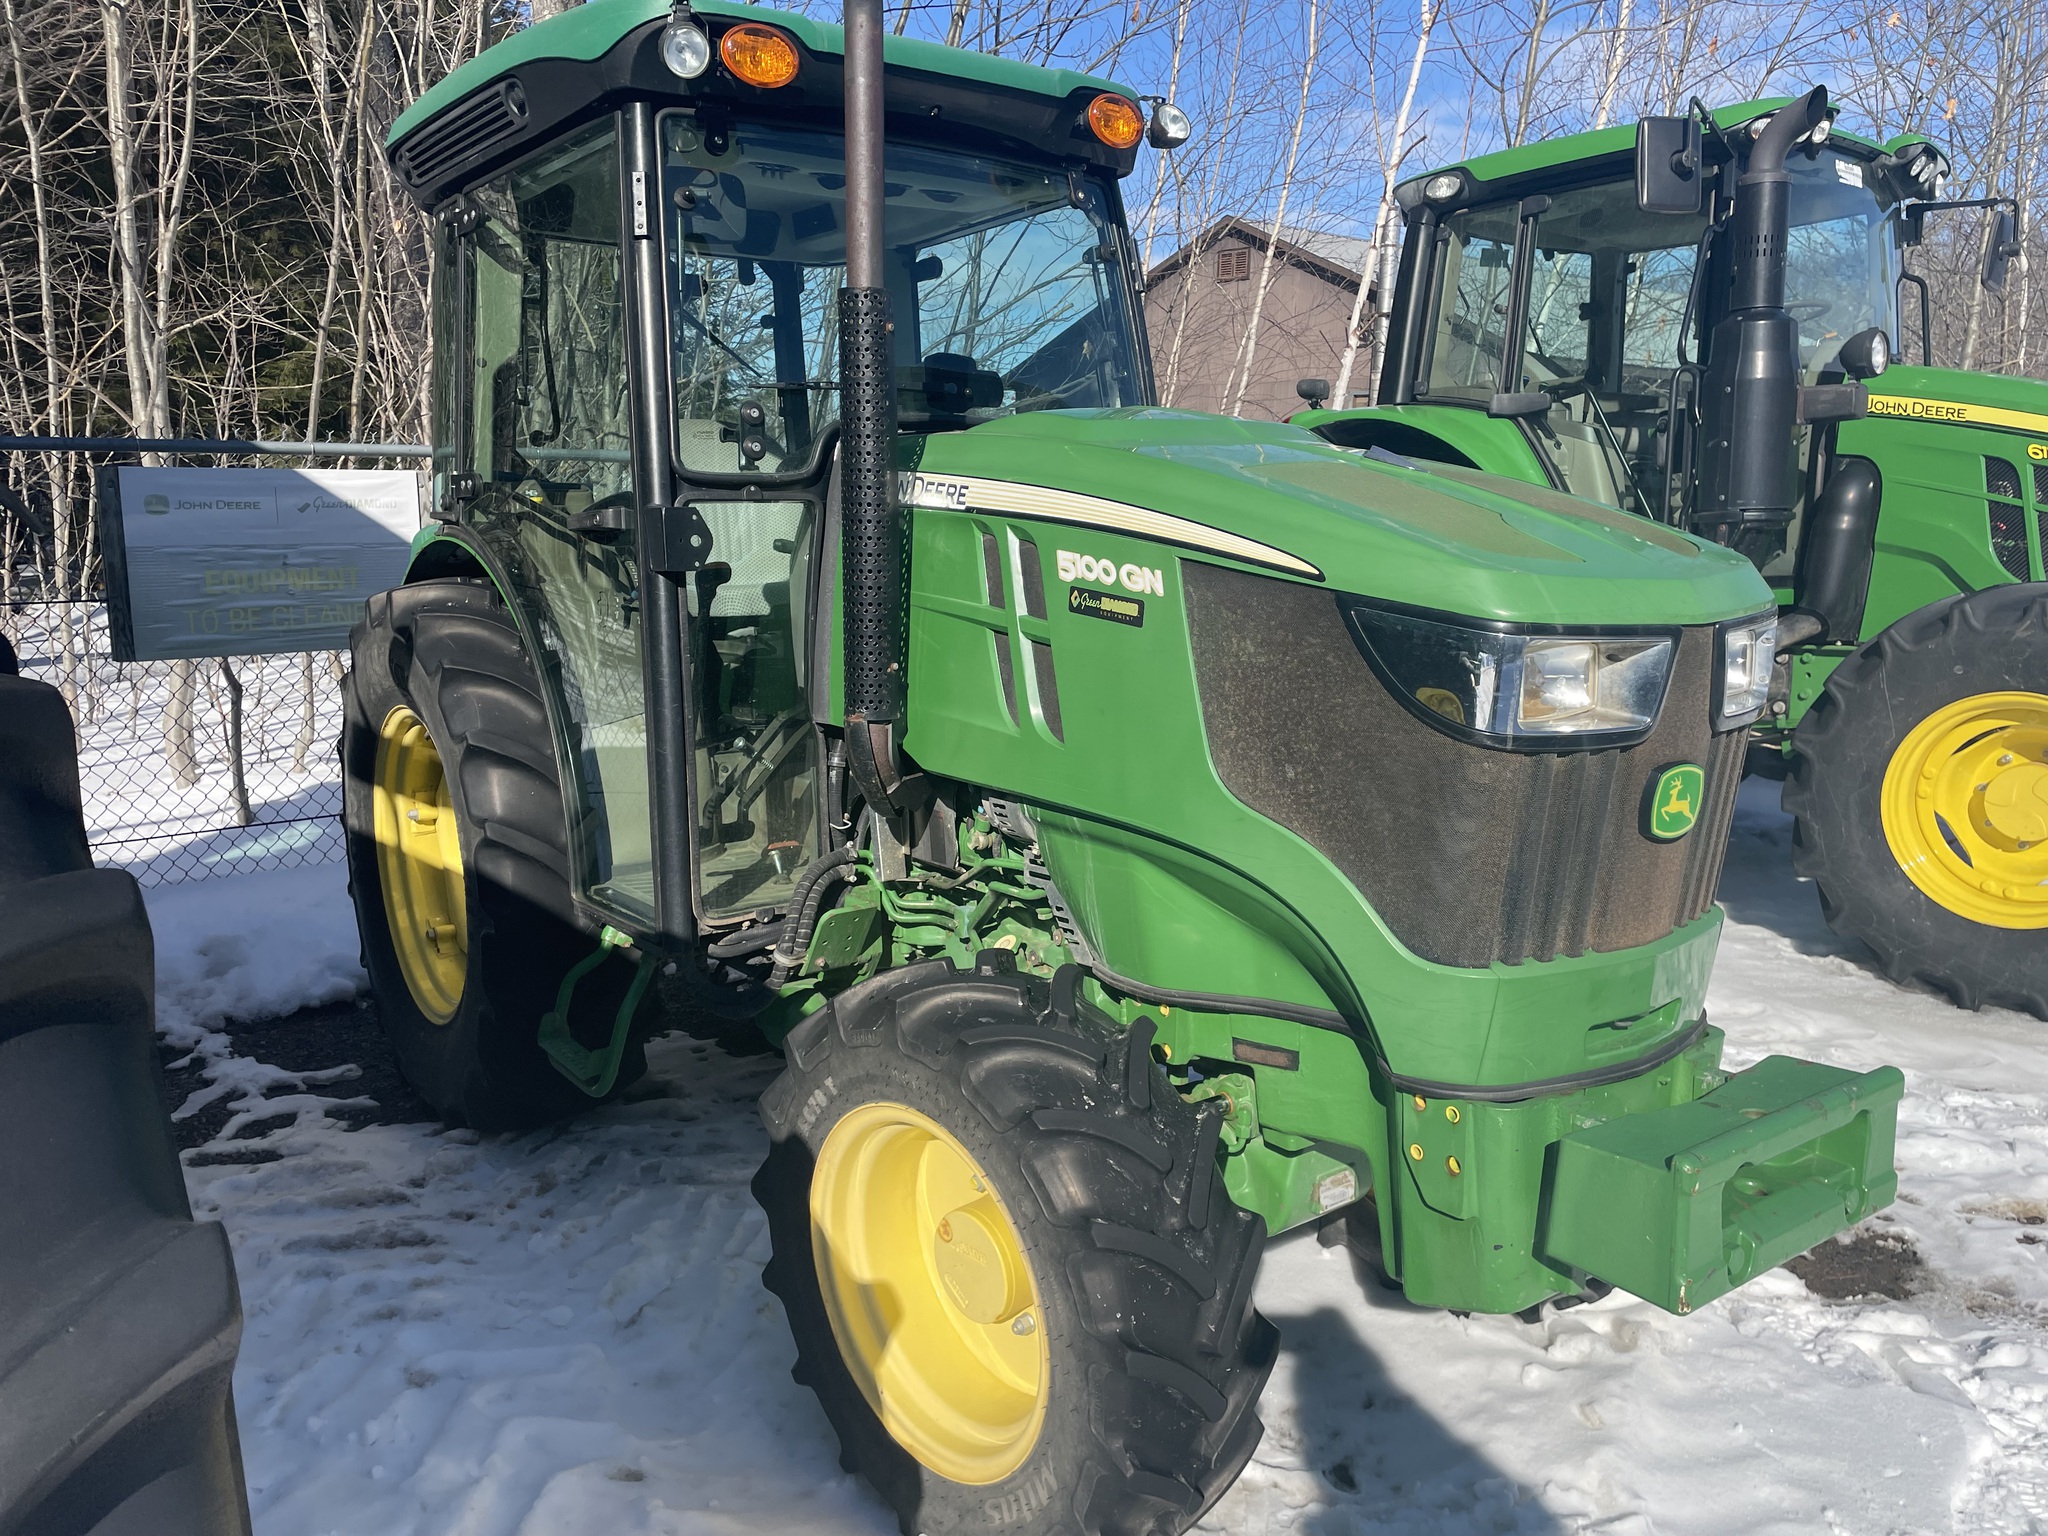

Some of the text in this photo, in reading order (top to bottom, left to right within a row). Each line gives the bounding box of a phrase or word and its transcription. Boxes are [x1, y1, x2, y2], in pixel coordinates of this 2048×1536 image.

[1867, 398, 1968, 419] JOHN DEERE
[2027, 443, 2048, 460] 61
[174, 499, 213, 511] JOHN
[214, 499, 261, 511] DEERE
[204, 567, 360, 595] EQUIPMENT
[1056, 548, 1165, 597] 5100 GN
[187, 603, 366, 635] TO BE CLEANE
